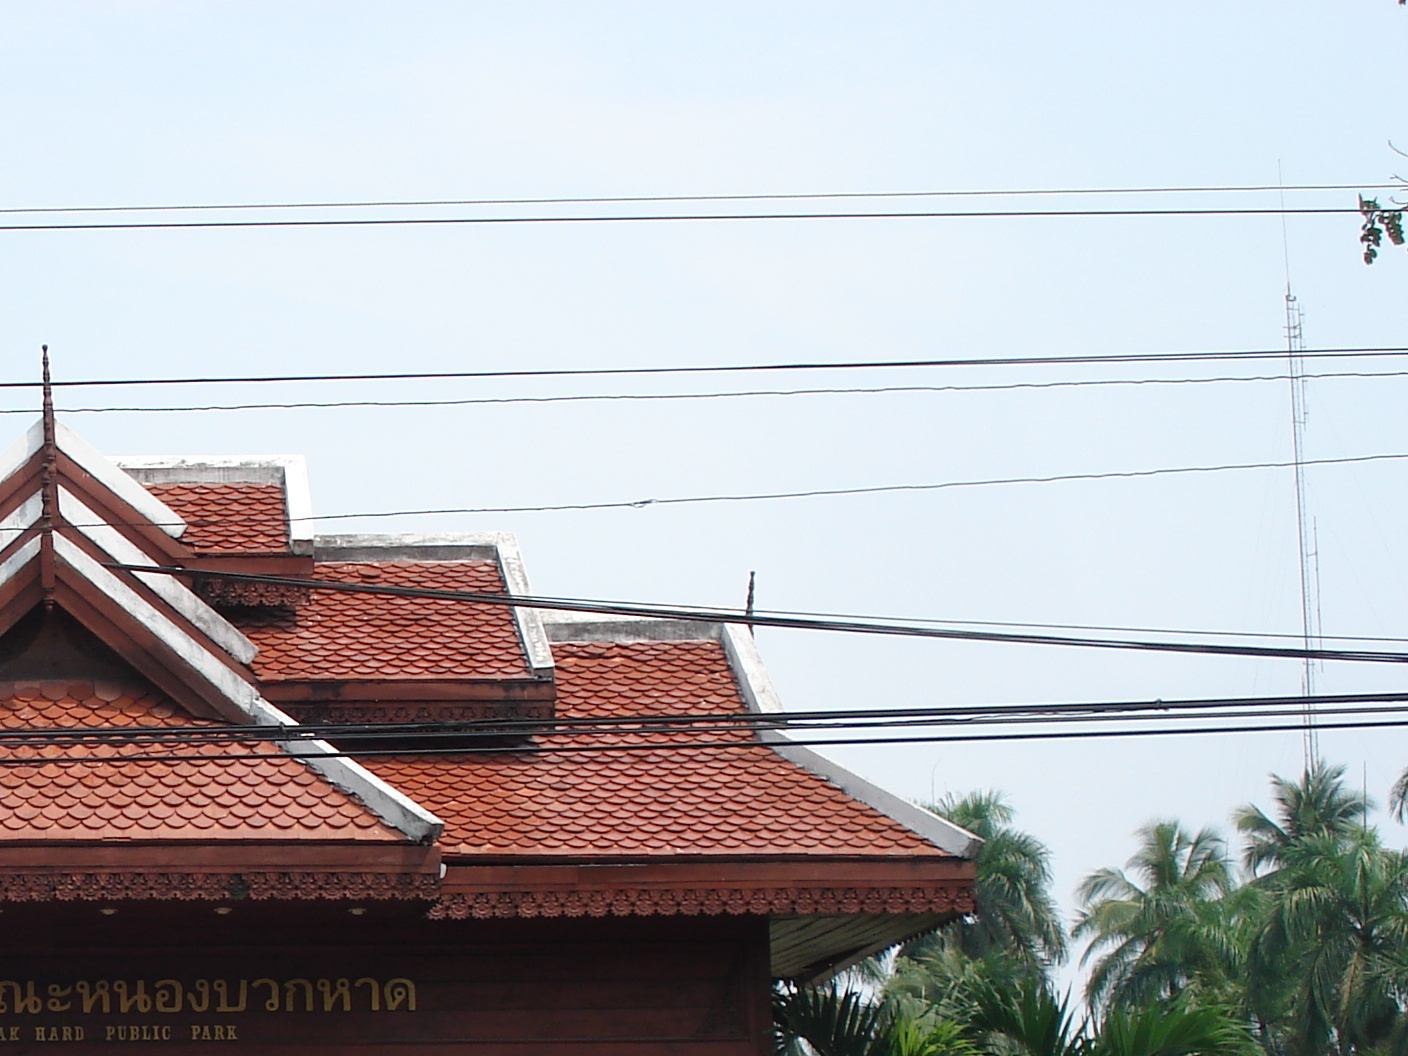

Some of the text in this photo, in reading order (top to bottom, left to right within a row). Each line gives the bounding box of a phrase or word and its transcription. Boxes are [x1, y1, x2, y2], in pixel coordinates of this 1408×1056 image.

[35, 1026, 85, 1041] HARD
[105, 1025, 171, 1041] PUBLIC
[191, 1025, 238, 1041] PARK
